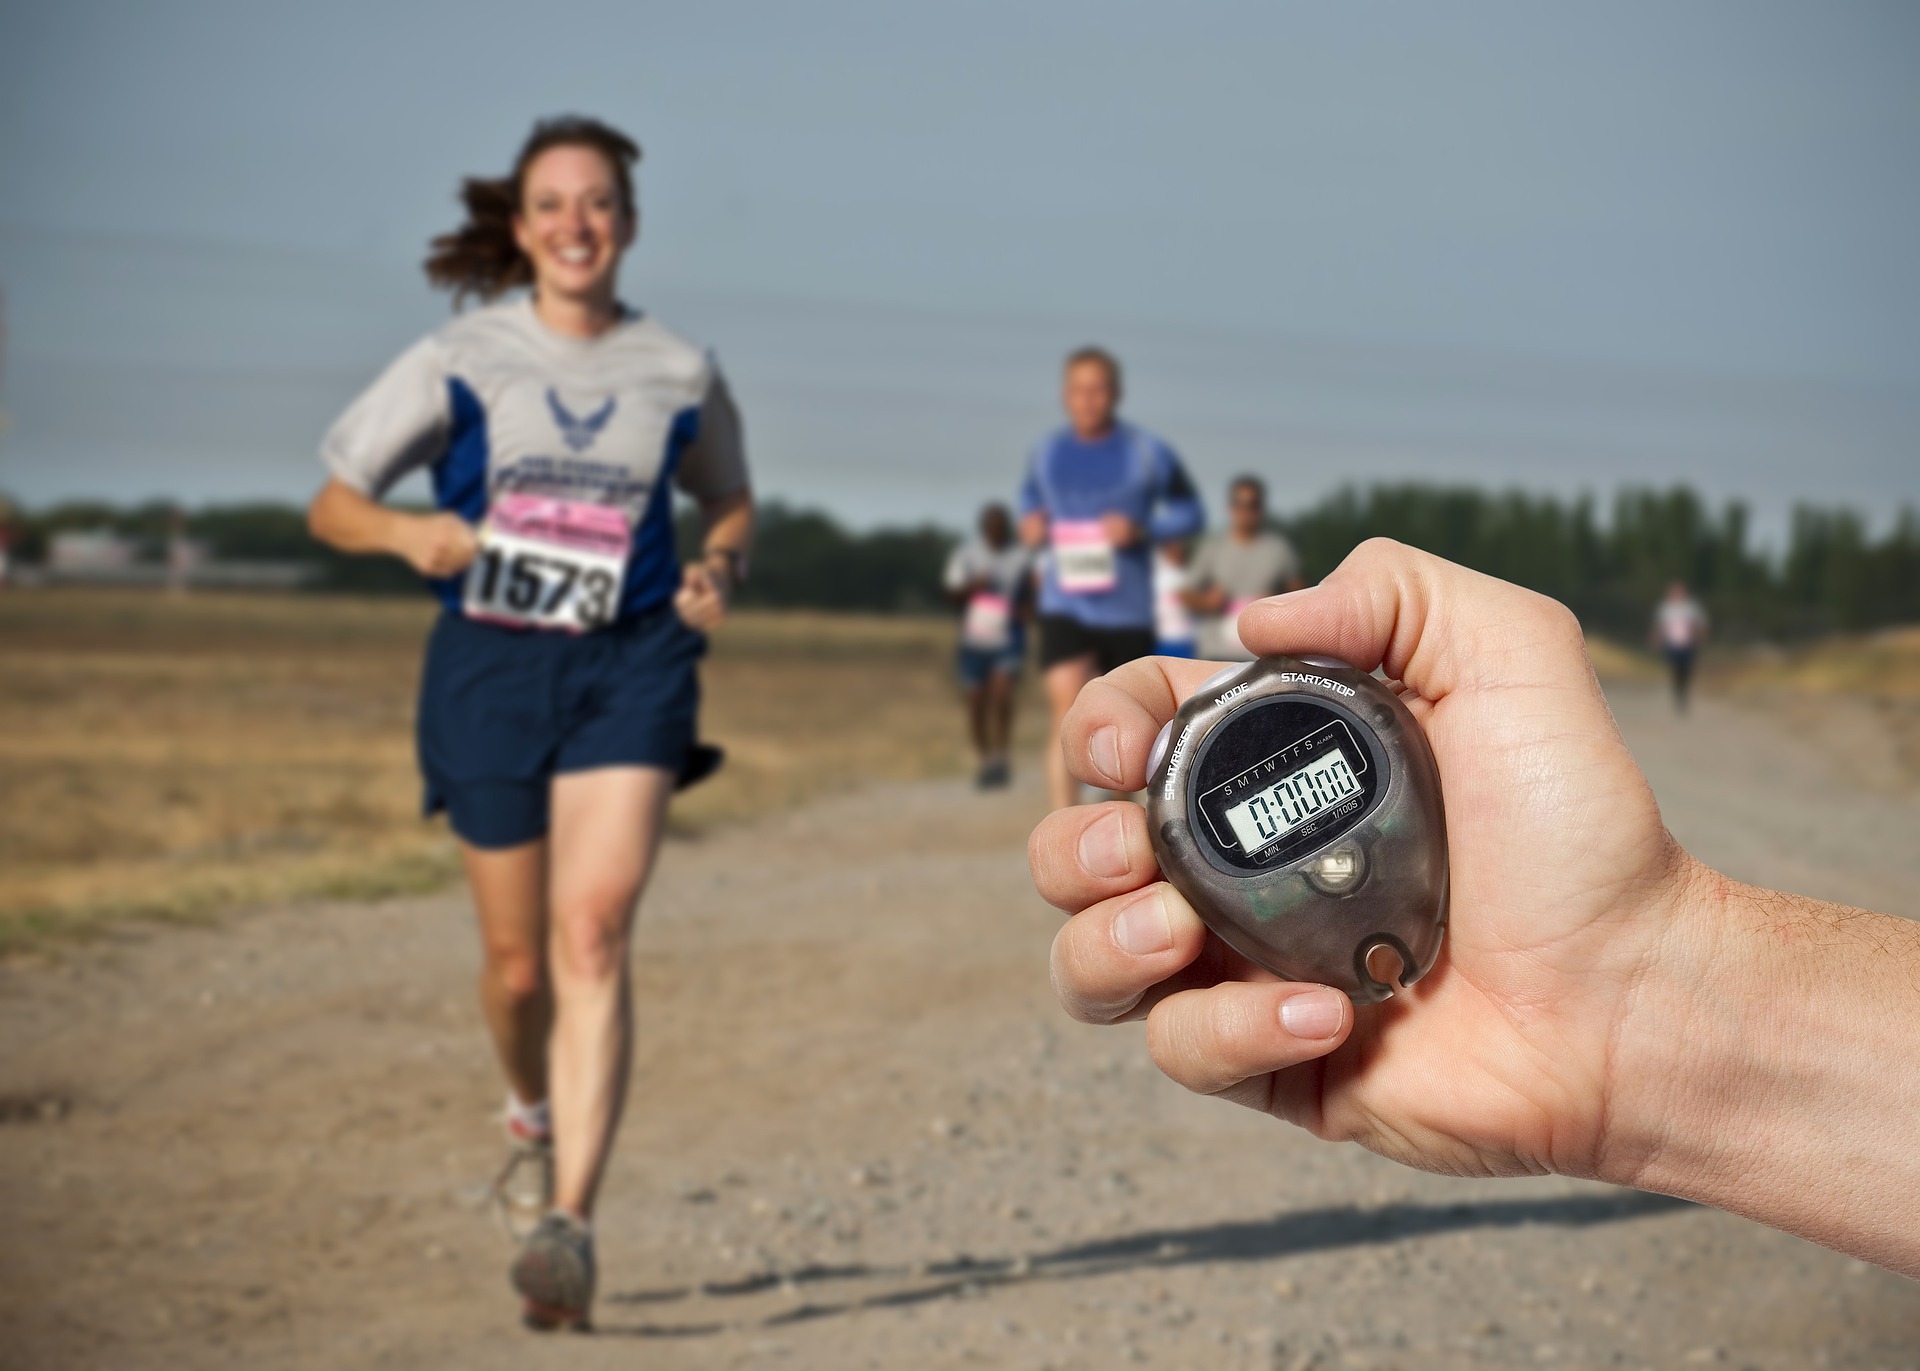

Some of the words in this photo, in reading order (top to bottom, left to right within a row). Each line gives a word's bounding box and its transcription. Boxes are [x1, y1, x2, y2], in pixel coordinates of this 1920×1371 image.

[481, 547, 615, 625] 1573
[1214, 682, 1249, 706] MODE
[1281, 672, 1356, 697] START/STOP
[1164, 724, 1191, 801] SPLIT/RESET
[1224, 785, 1233, 796] S
[1237, 776, 1249, 788] M
[1253, 769, 1260, 779] T
[1264, 760, 1275, 772] W
[1281, 753, 1288, 763] T
[1293, 746, 1301, 757] F
[1305, 740, 1313, 751] S
[1264, 844, 1281, 858] MIN.
[1301, 823, 1319, 837] SEC.
[1332, 799, 1358, 820] 1/100S
